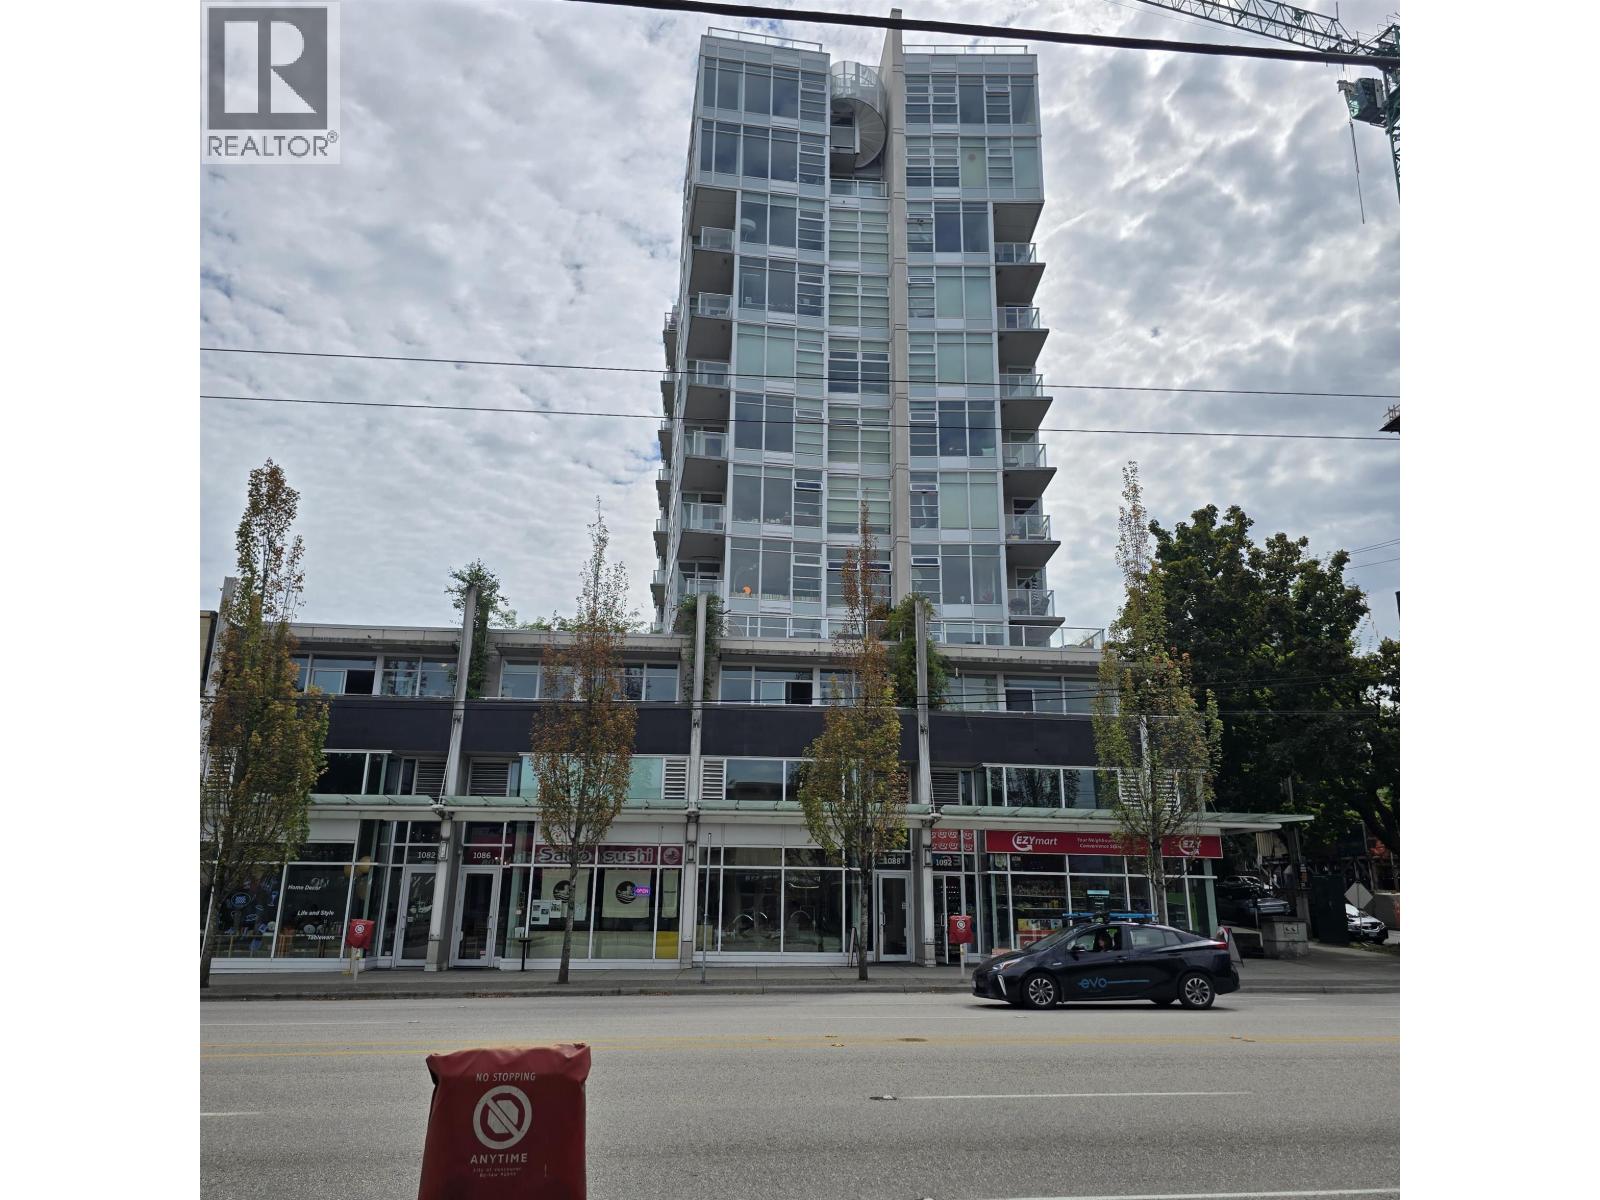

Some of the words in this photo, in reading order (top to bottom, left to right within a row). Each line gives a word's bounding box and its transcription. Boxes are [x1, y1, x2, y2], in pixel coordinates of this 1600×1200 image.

[417, 851, 436, 859] 1082
[473, 851, 491, 859] 1086
[603, 848, 654, 863] sushi
[936, 859, 952, 867] 1092
[1080, 976, 1107, 988] evo
[476, 1073, 489, 1082] NO
[493, 1072, 536, 1082] STOPPING
[470, 1153, 528, 1164] ANYTIME
